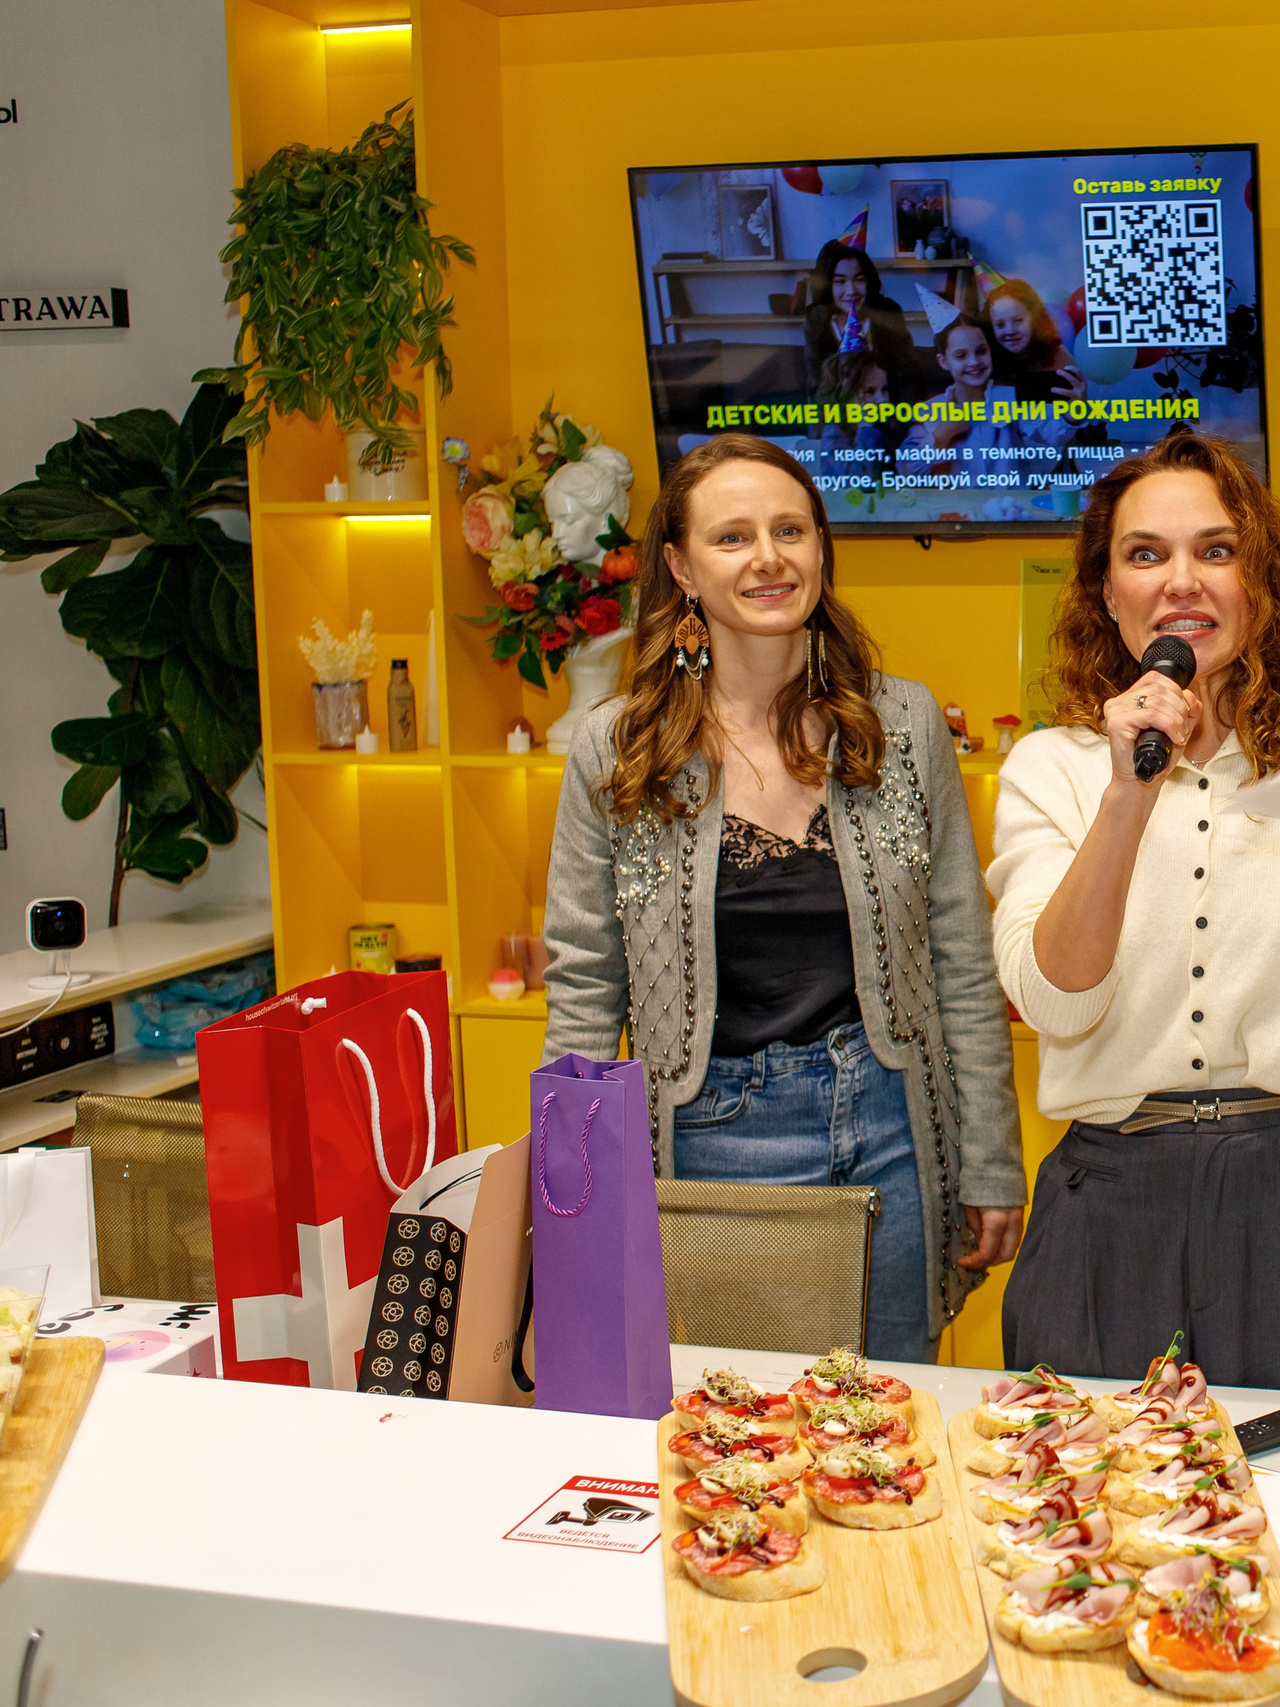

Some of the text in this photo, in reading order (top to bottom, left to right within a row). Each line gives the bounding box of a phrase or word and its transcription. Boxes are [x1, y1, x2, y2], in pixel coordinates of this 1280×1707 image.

[1073, 177, 1222, 195] Оставь заявку
[706, 398, 1200, 429] ДЕТСКИЕ И ВЗРОСЛЫЕ ДНИ РОЖДЕНИЯ
[834, 448, 891, 464] квест,
[896, 445, 957, 465] мафия
[963, 448, 974, 460] в
[979, 446, 1062, 462] темноте,
[1068, 446, 1125, 461] пицца
[882, 470, 971, 491] Бронируй
[975, 470, 1021, 487] свой
[1025, 469, 1096, 489] лучший
[245, 992, 298, 1021] houseofswitzerland.org
[517, 1531, 639, 1549] ВИДЕОНАБЛЮДЕНИЕ
